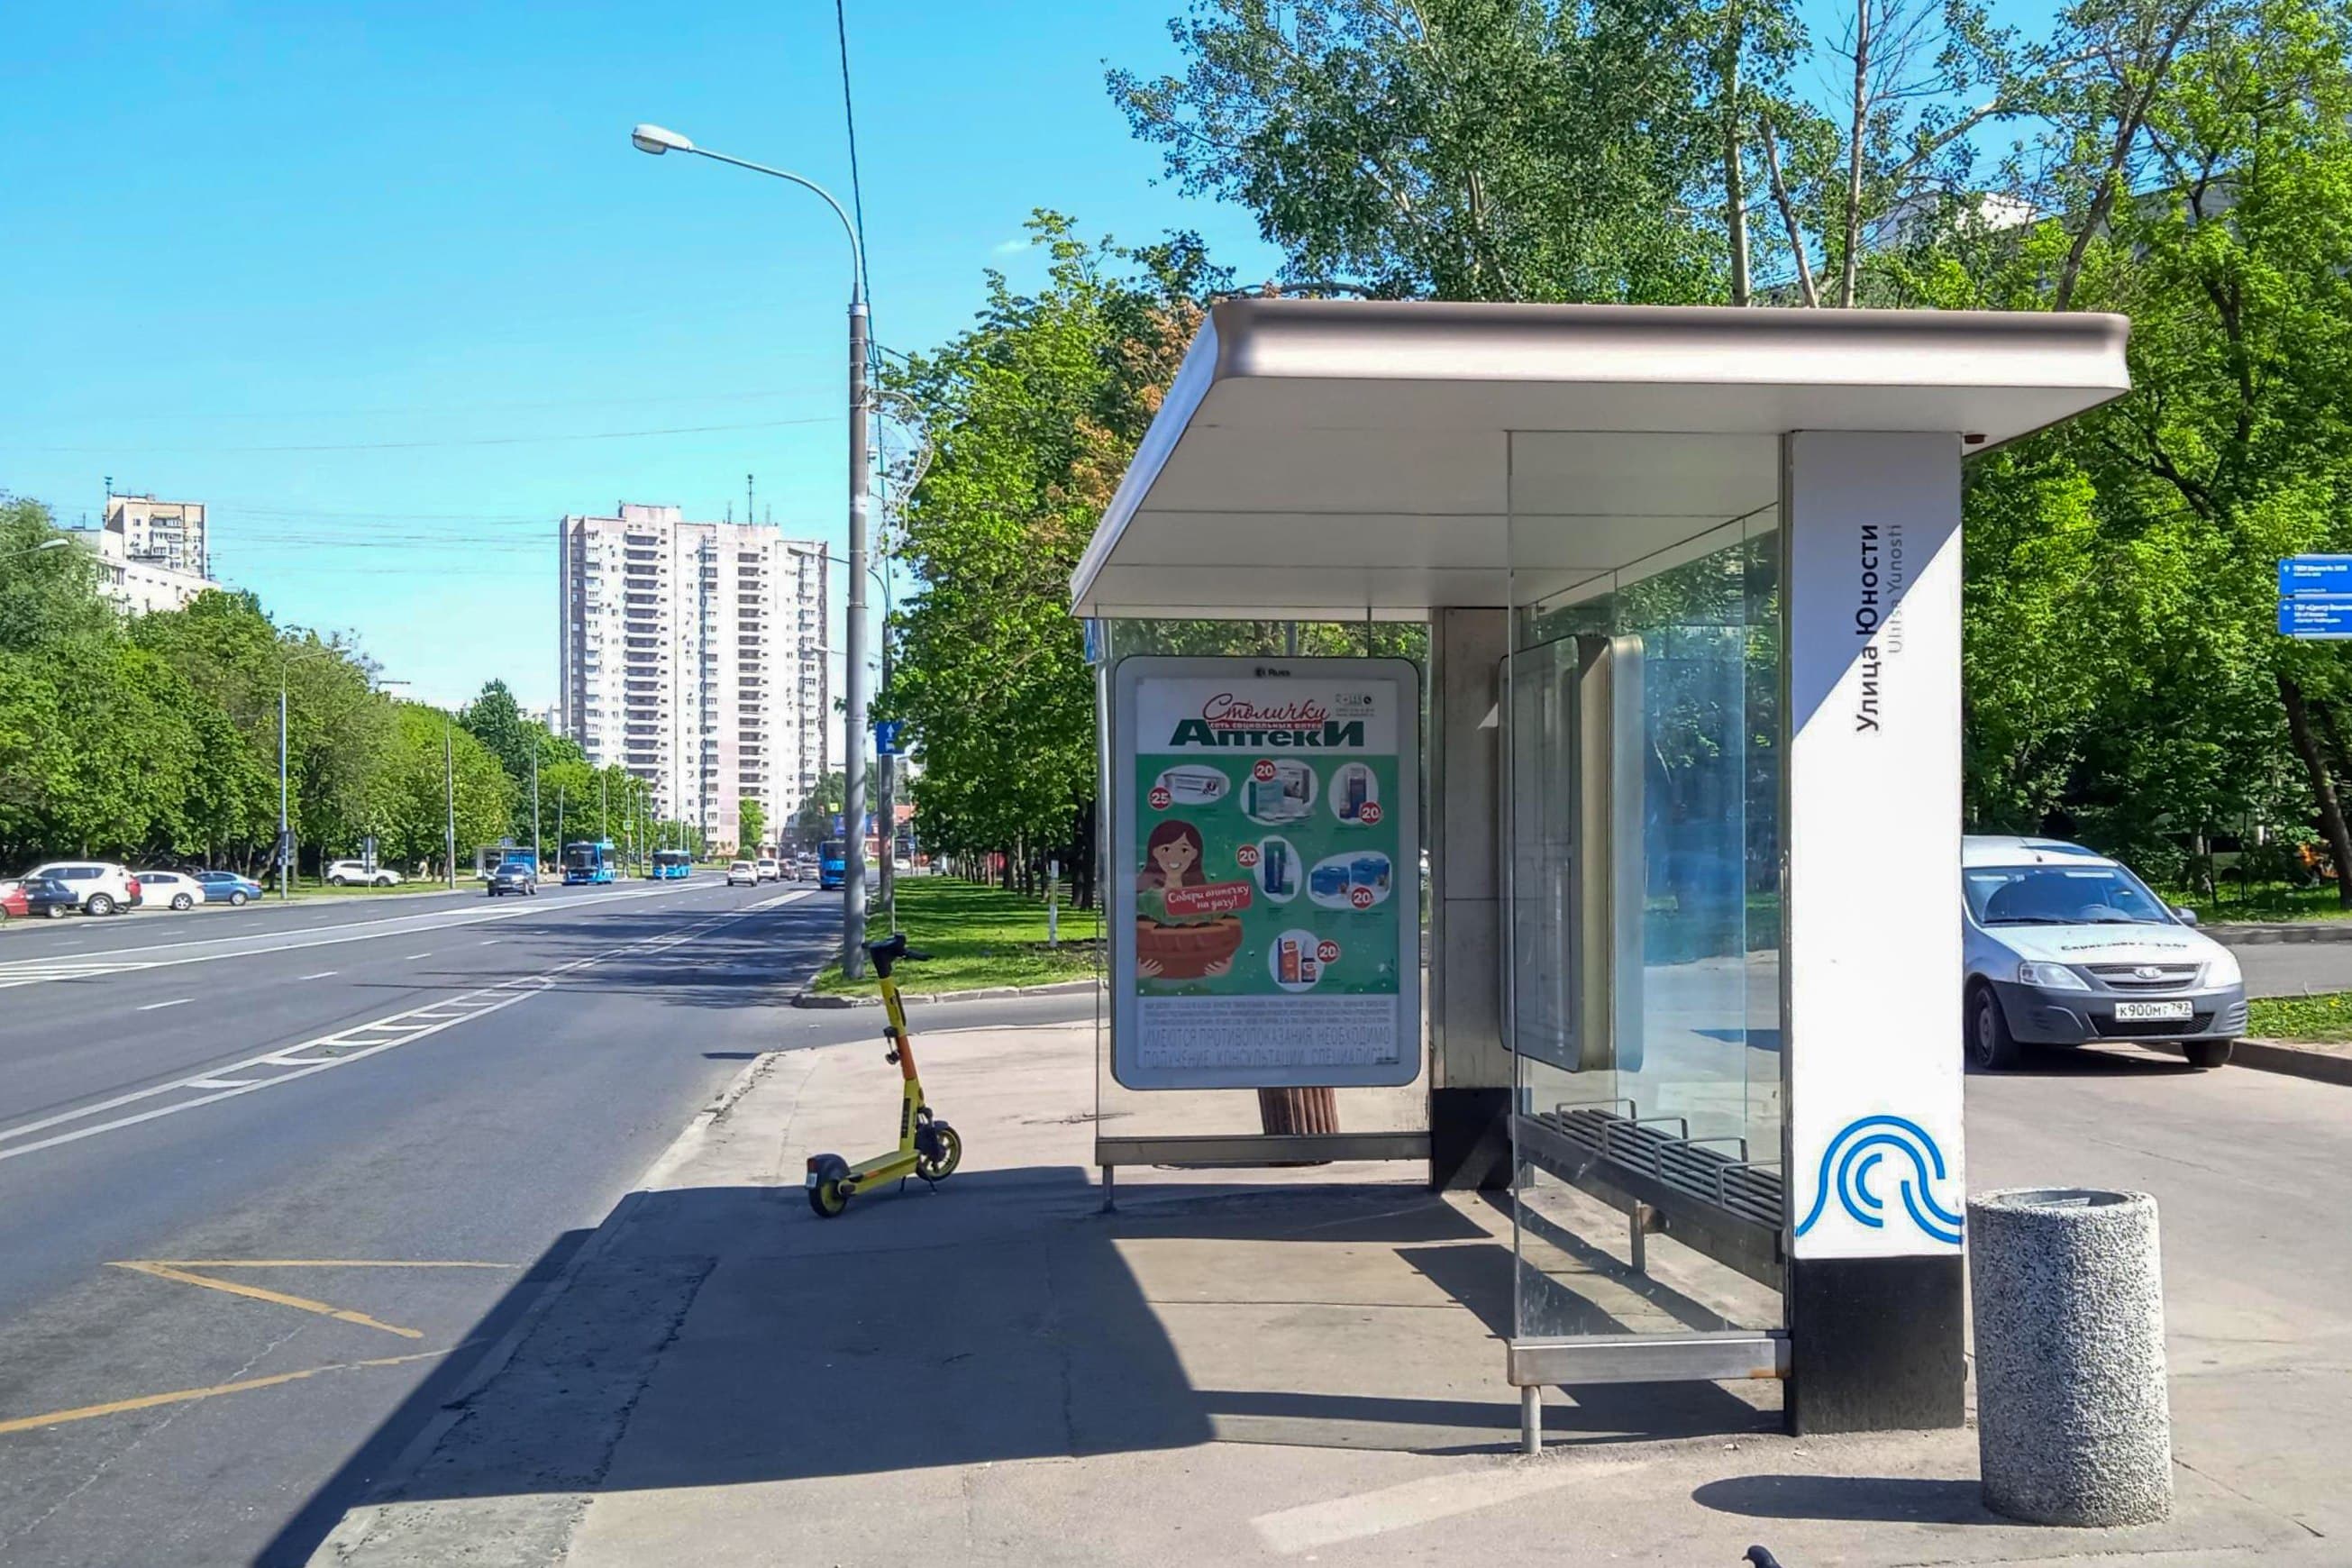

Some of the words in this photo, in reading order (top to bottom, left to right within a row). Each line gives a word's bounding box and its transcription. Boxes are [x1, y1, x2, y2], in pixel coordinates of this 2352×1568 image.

[1886, 524, 1902, 595] Yunosti
[1855, 524, 1879, 634] Юности
[1856, 646, 1882, 732] Улица
[1202, 692, 1331, 722] Столички
[1255, 764, 1274, 777] 20
[1151, 792, 1169, 805] 25
[1362, 807, 1380, 819] 20
[1239, 851, 1257, 863] 20
[1354, 891, 1372, 904] 20
[1319, 945, 1337, 957] 20
